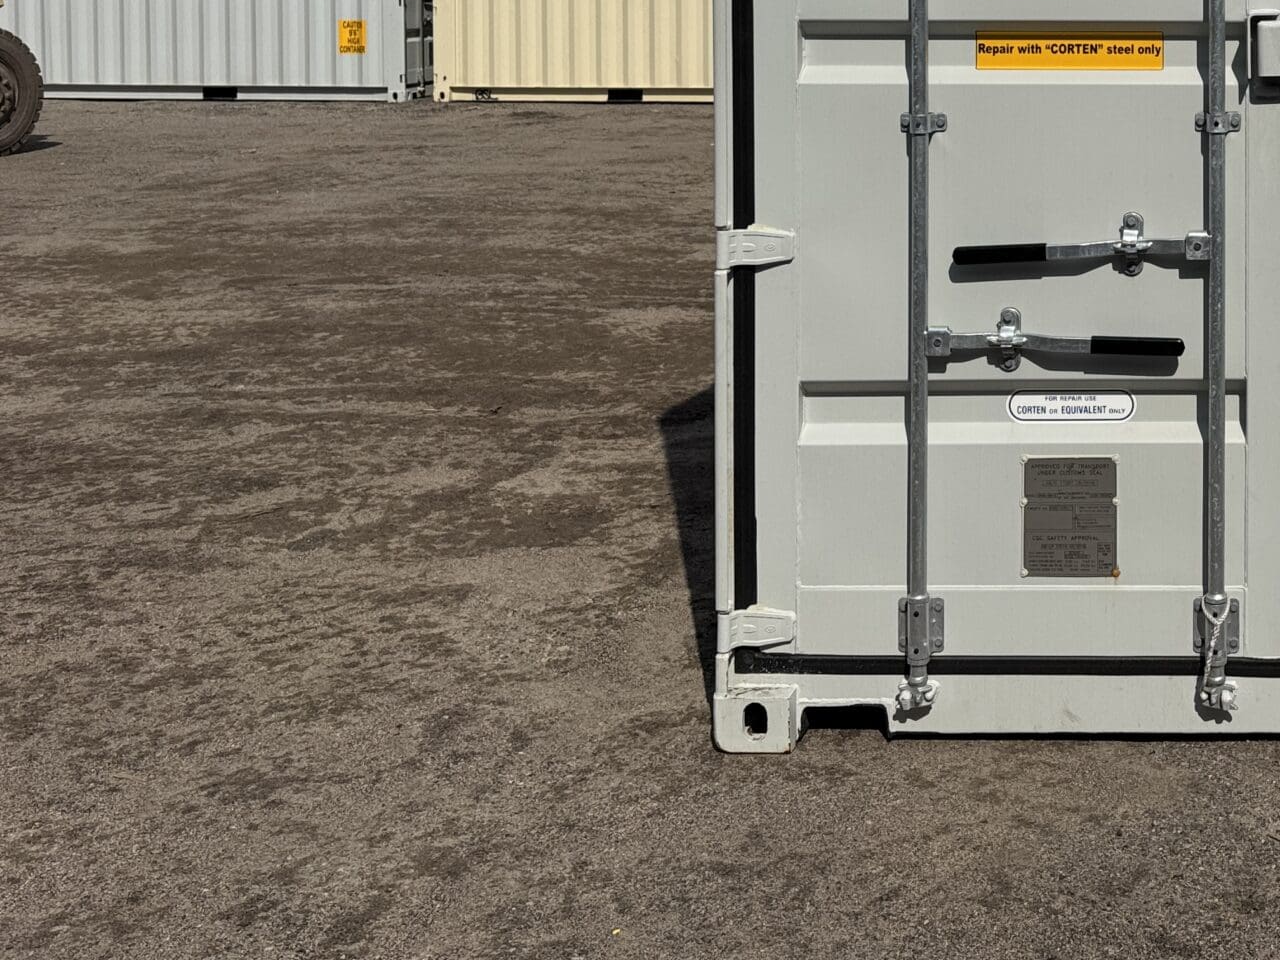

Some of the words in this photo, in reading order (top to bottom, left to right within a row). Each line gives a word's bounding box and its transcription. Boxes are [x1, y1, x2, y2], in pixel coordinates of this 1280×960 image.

[978, 43, 1015, 56] Repair
[1017, 43, 1042, 54] with
[1107, 44, 1134, 54] steel
[1138, 44, 1161, 57] only
[1017, 405, 1046, 415] CORTEN
[1061, 405, 1107, 415] EQUIVALENT
